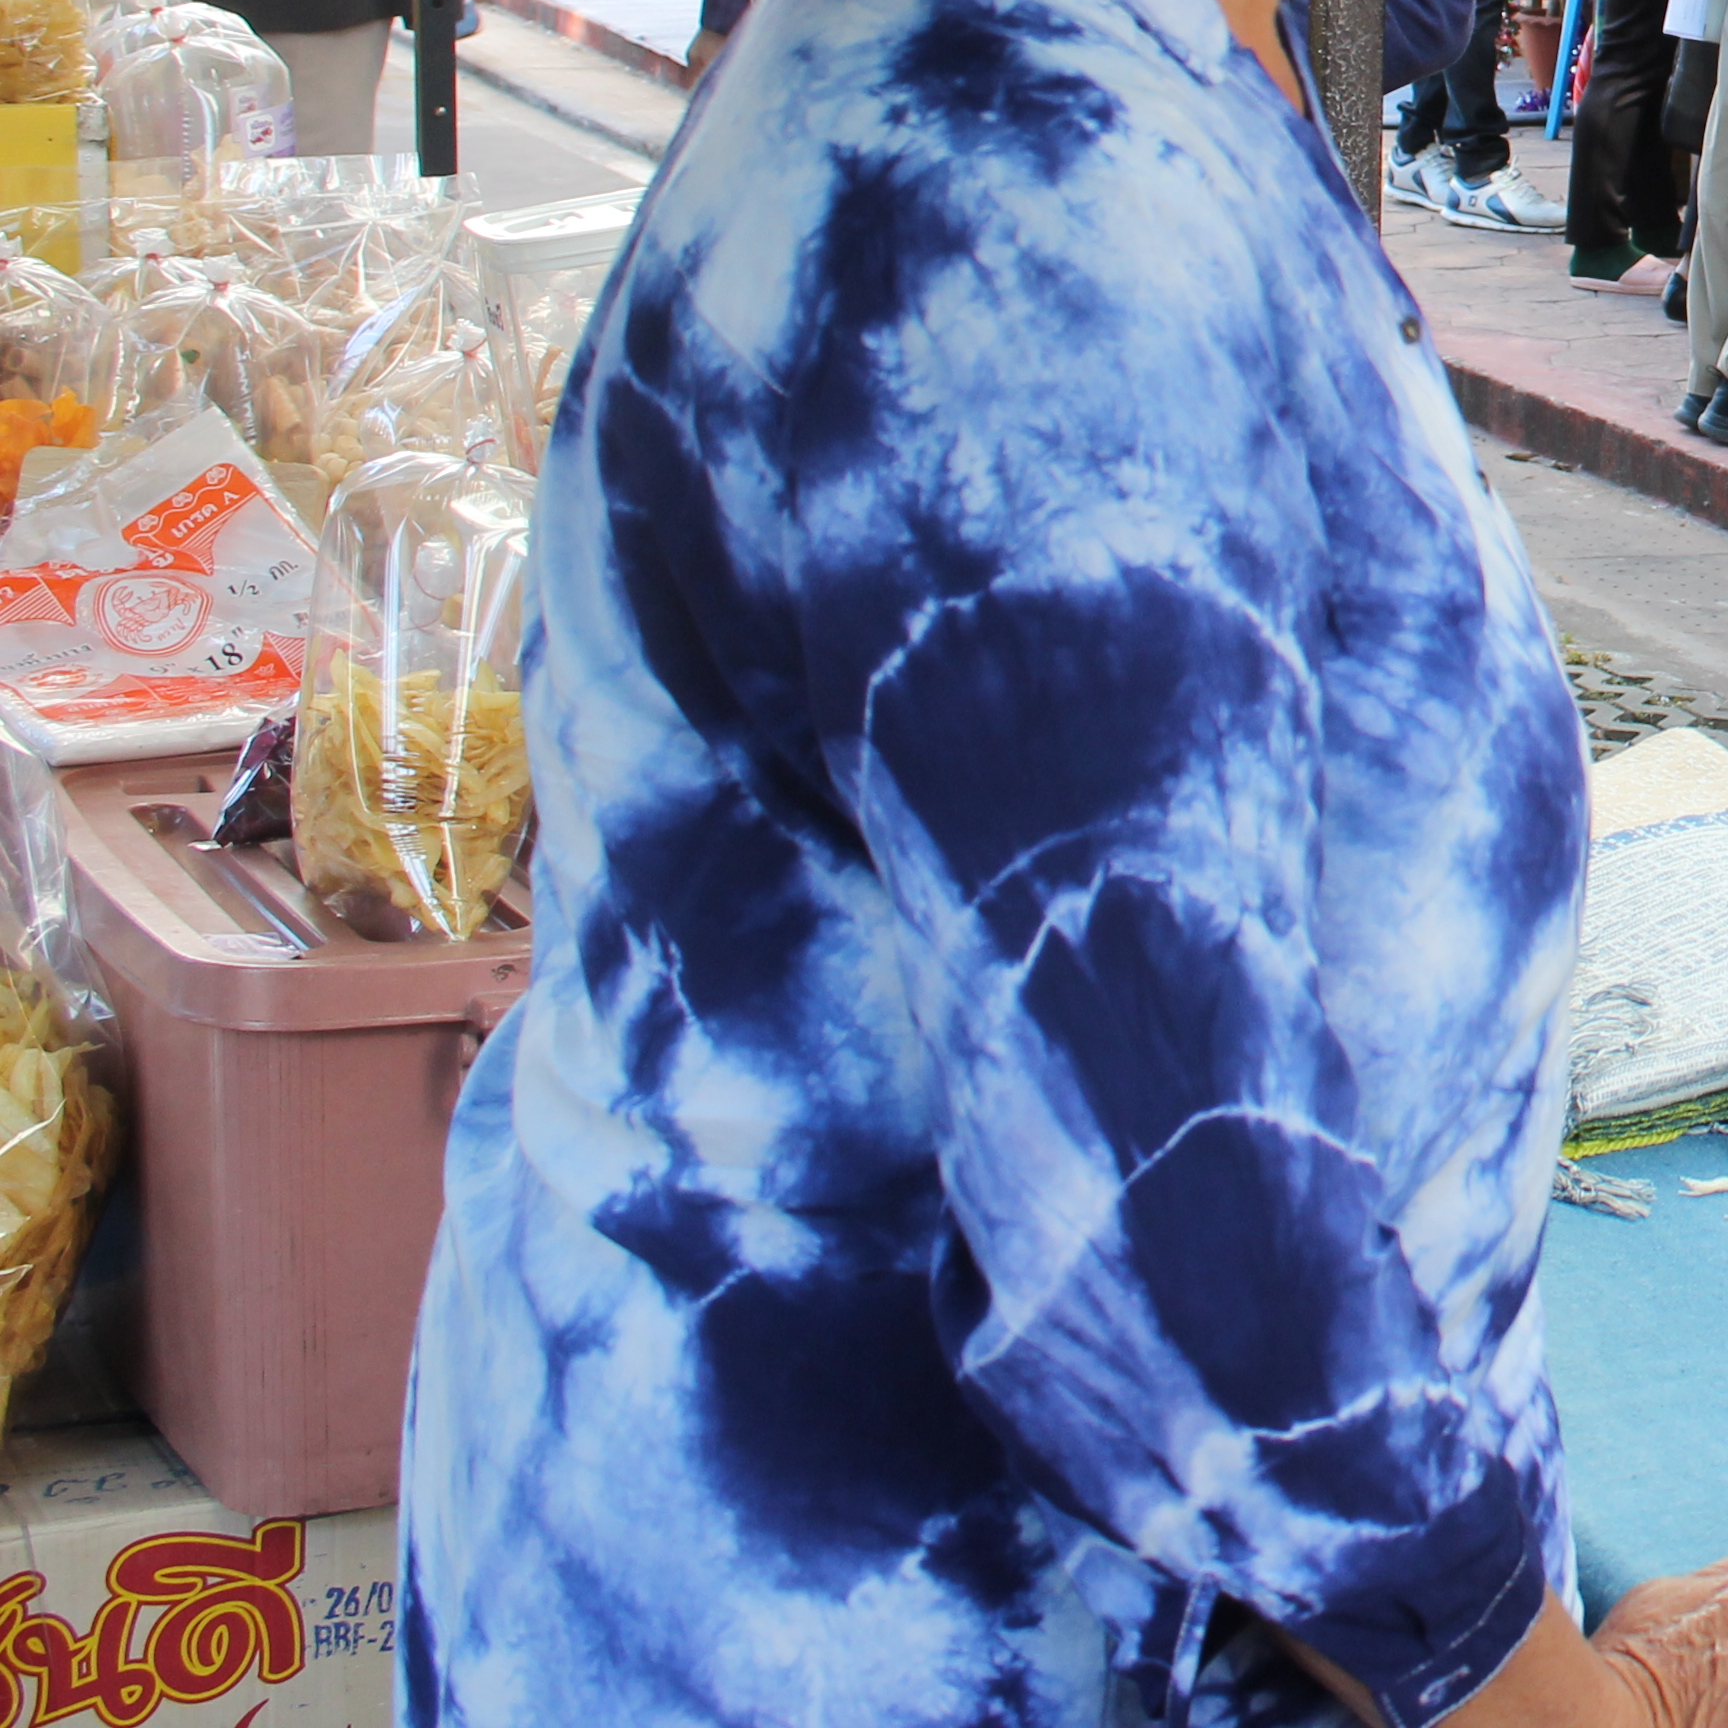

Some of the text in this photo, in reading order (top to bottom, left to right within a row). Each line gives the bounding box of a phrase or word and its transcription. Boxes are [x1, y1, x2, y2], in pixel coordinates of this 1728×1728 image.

[170, 490, 241, 539] เกรด A
[227, 560, 299, 597] 1/2 กก.
